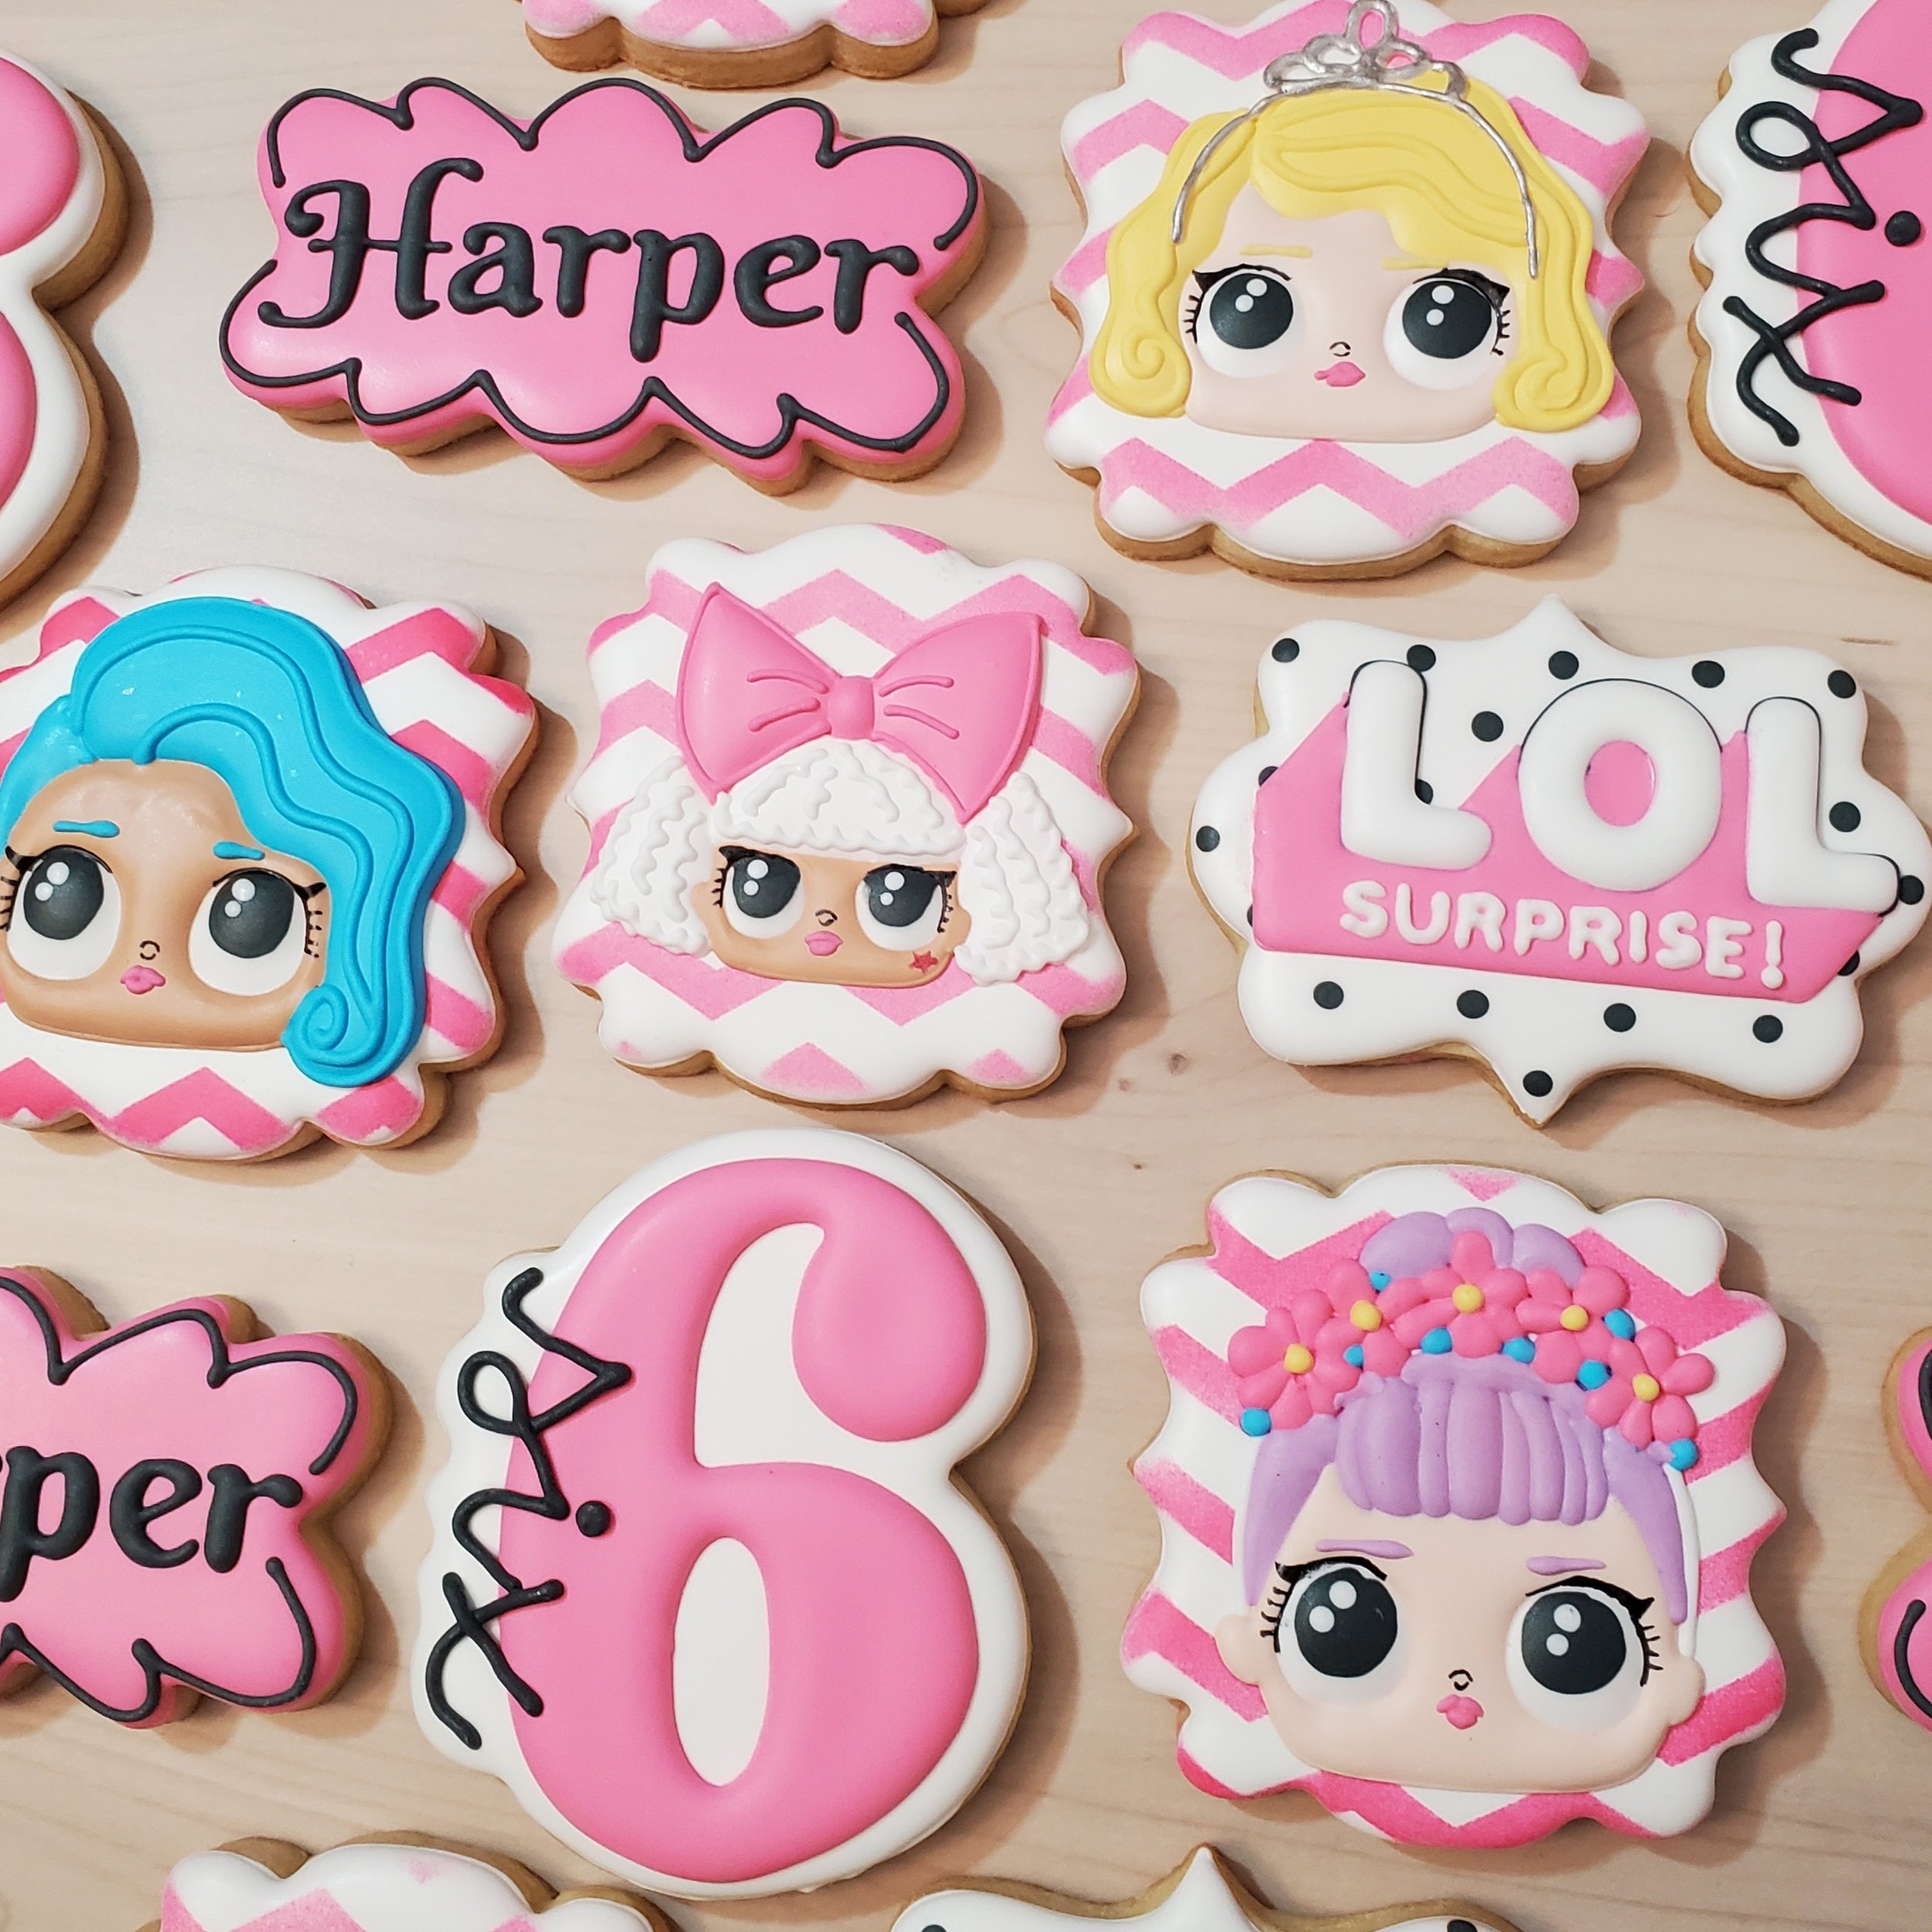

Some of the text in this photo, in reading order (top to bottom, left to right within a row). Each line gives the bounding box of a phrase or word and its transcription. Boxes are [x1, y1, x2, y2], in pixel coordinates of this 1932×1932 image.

[258, 156, 920, 363] Harper
[1723, 28, 1923, 447] six
[1340, 660, 1898, 912] LOL
[1338, 879, 1784, 990] SURPRISE!
[0, 1445, 304, 1603] per
[425, 1267, 633, 1750] six
[500, 1157, 987, 1884] 6
